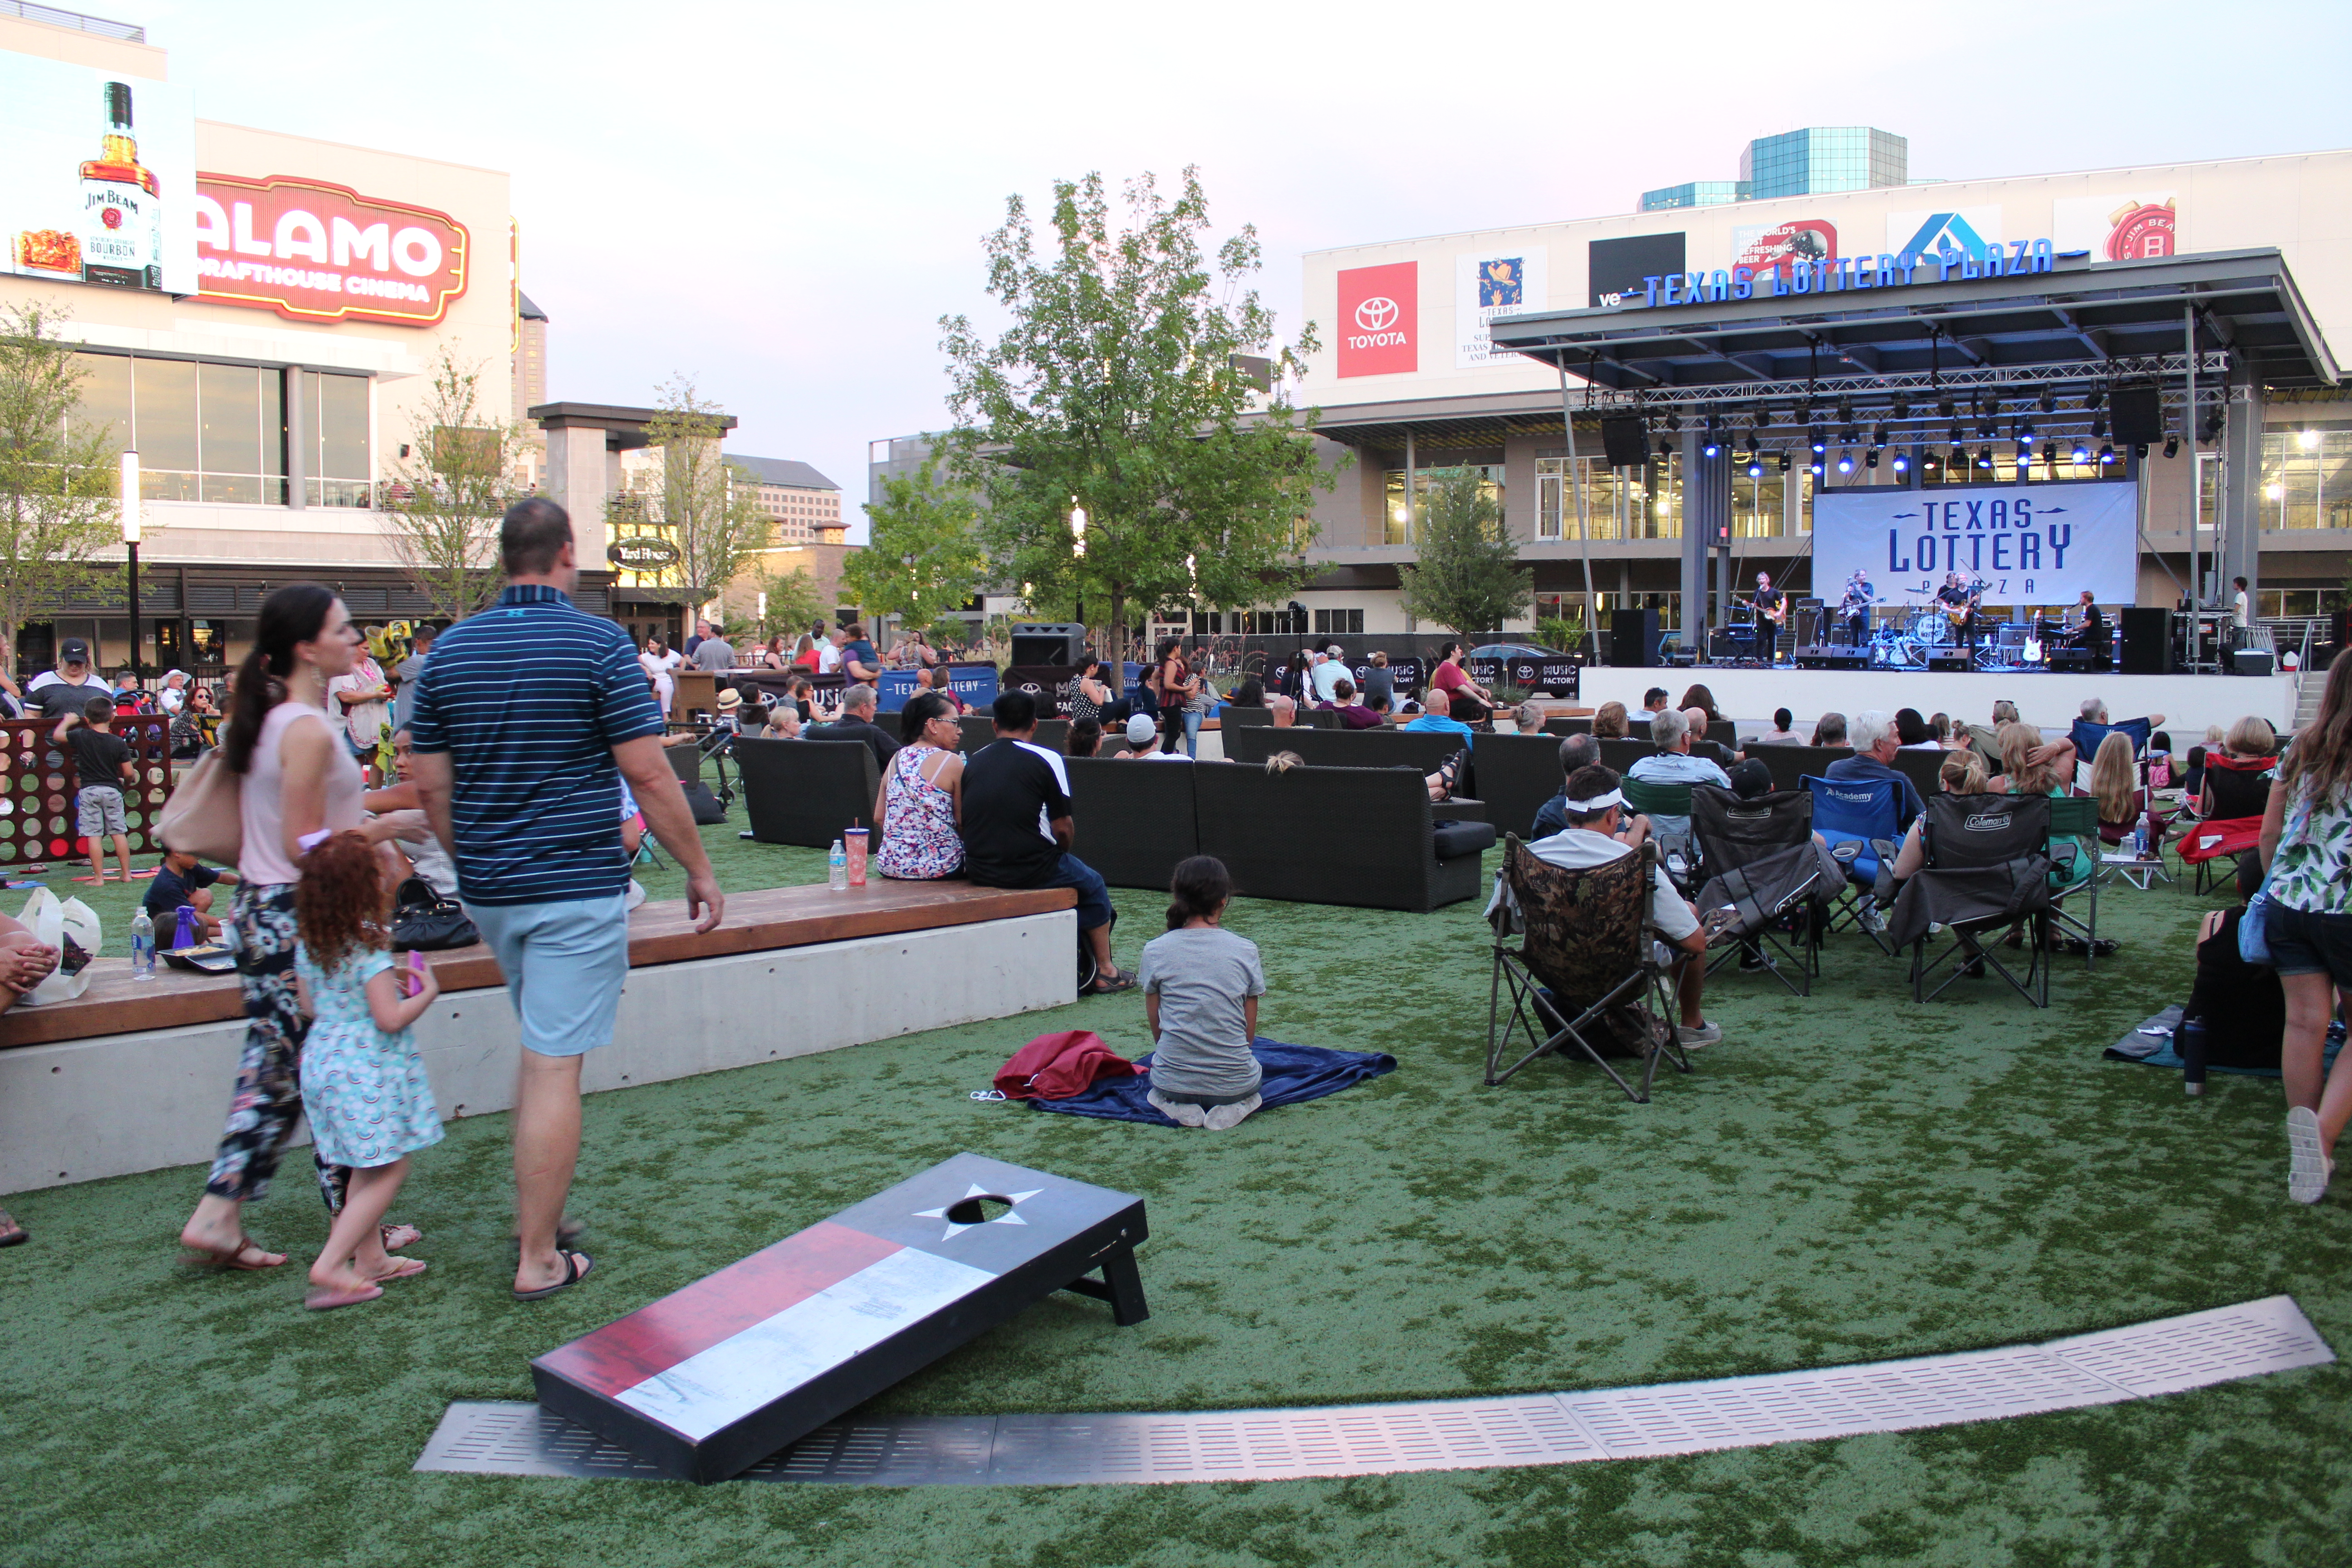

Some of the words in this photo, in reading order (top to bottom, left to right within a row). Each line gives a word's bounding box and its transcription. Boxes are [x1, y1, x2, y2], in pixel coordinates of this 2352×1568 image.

[85, 193, 105, 210] JIM
[108, 189, 138, 215] BEAM
[196, 194, 442, 276] ALAMO
[1738, 230, 1755, 238] THE
[1757, 226, 1796, 236] WORLD'S
[2127, 224, 2144, 242] JIM
[2148, 219, 2175, 234] BEA
[90, 242, 135, 257] BOURBON
[1739, 237, 1764, 247] MOST
[1739, 244, 1793, 256] REFRESHING
[1738, 255, 1760, 264] BEER
[1643, 267, 1753, 307] TEXAS
[1773, 251, 1916, 296] LOTTERY
[1940, 238, 2053, 281] PLAZA
[346, 276, 430, 302] CINEMA
[1487, 306, 1513, 316] TEXAS
[1348, 331, 1406, 349] TOYOTA
[1461, 343, 1488, 352] TEXAS
[1469, 353, 1486, 361] AND
[1922, 499, 2031, 531] TEXAS
[1889, 524, 2070, 572] LOTTERY
[1922, 578, 2034, 595] PZA
[813, 687, 848, 706] USi
[1835, 790, 1872, 802] Academy
[1969, 817, 2002, 826] Coleman
